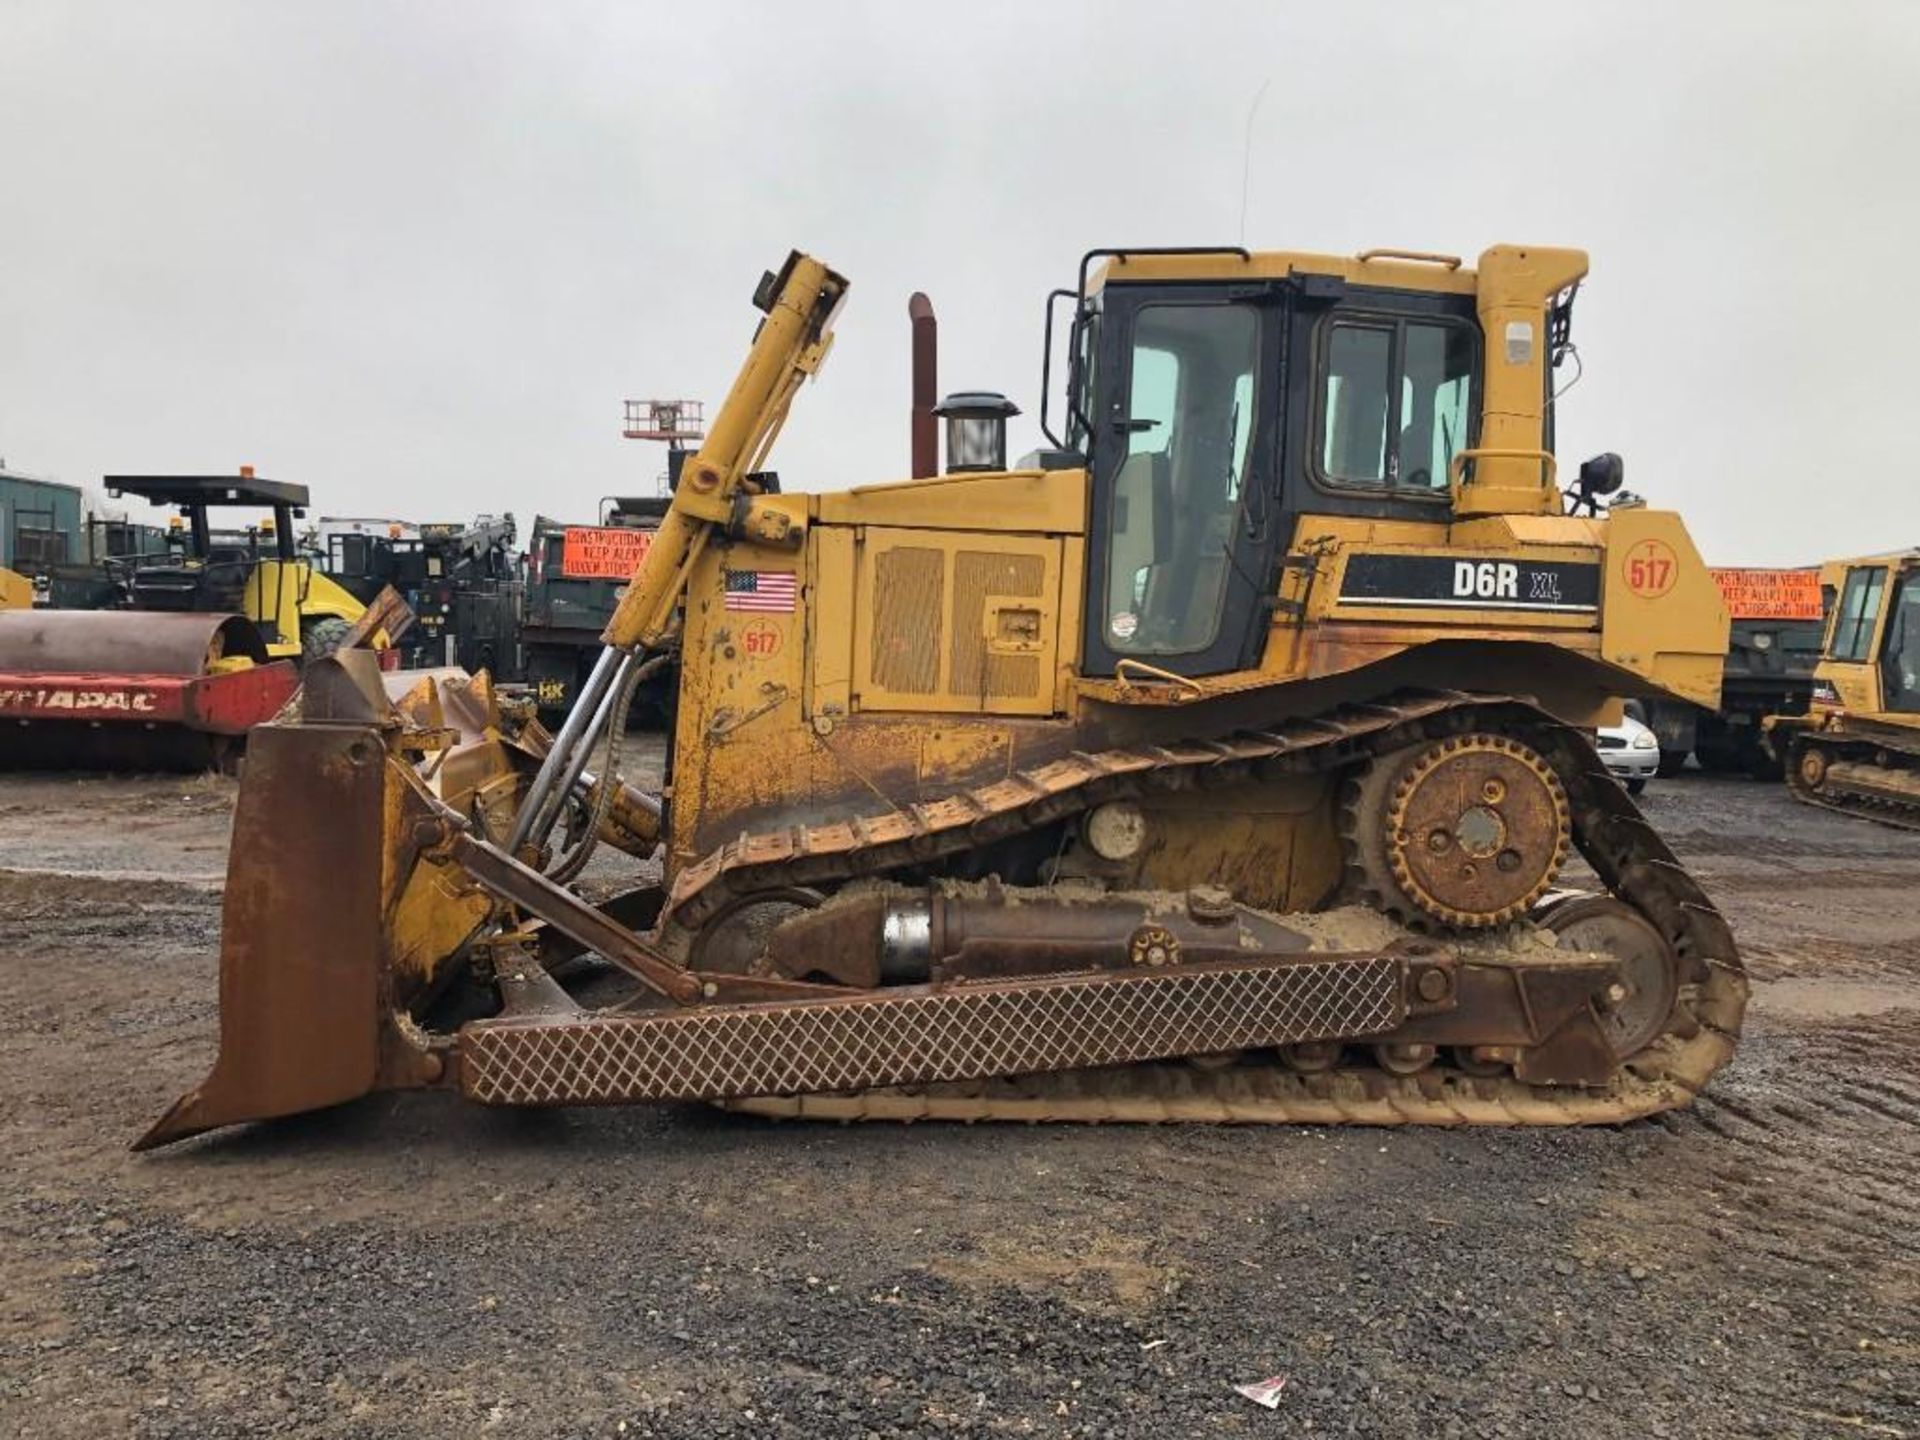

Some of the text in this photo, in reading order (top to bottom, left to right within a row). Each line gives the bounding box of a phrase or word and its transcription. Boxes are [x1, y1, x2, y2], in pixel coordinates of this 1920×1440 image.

[566, 530, 642, 546] CONSTRUCTION
[583, 546, 644, 561] KEEP ALERT
[1645, 544, 1658, 557] T
[1453, 561, 1562, 600] D6R XL
[1631, 559, 1671, 589] 517
[1780, 573, 1820, 588] VEHICLE
[1722, 587, 1748, 601] KEEP
[1751, 588, 1781, 602] ALERT
[746, 631, 777, 653] 517
